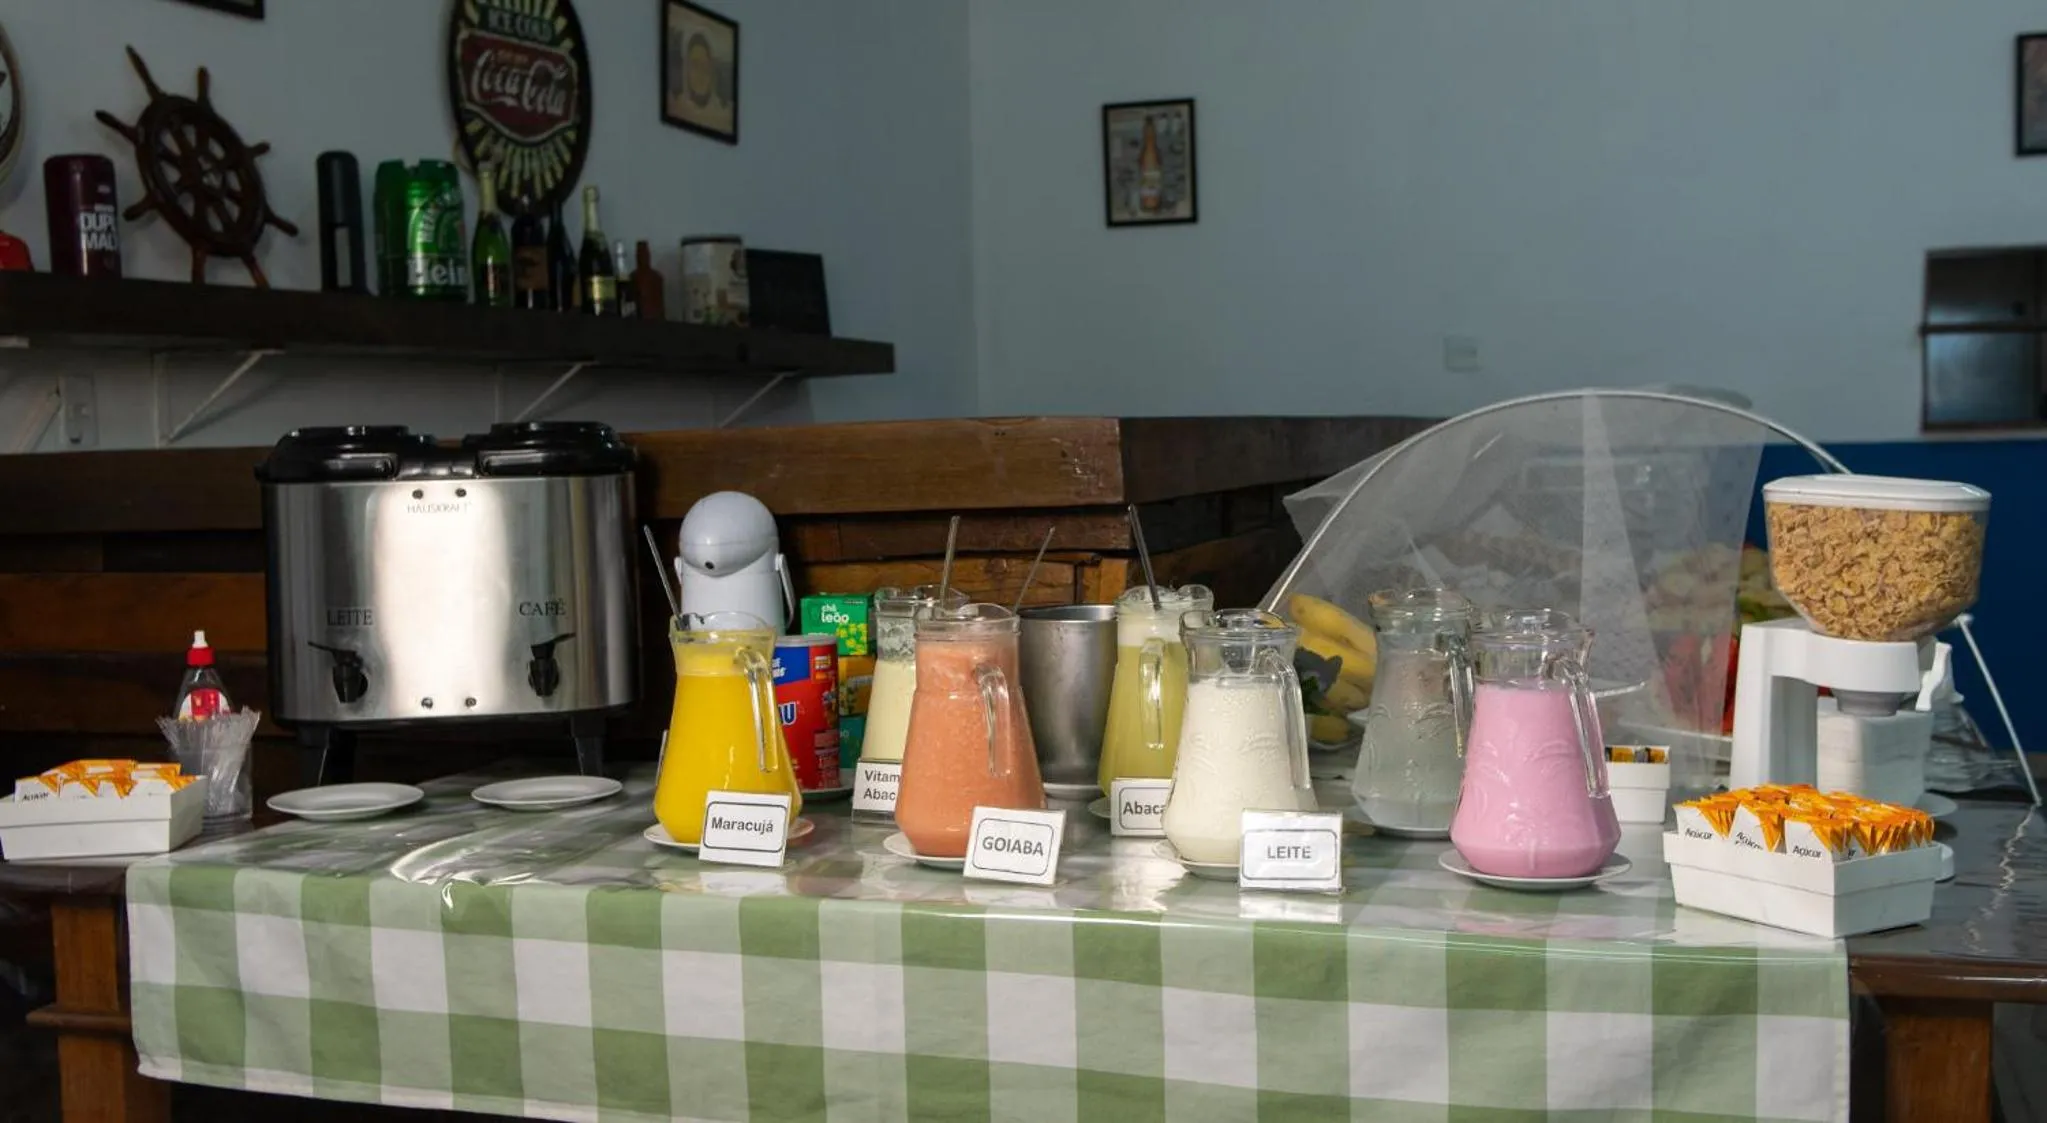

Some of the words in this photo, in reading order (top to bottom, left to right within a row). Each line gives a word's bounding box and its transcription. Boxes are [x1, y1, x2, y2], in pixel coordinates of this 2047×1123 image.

[326, 608, 374, 626] LEITE
[519, 597, 567, 617] CAFÉ
[711, 816, 774, 836] Maracujá
[980, 835, 1044, 857] GOIABA
[1267, 845, 1312, 860] LEITE
